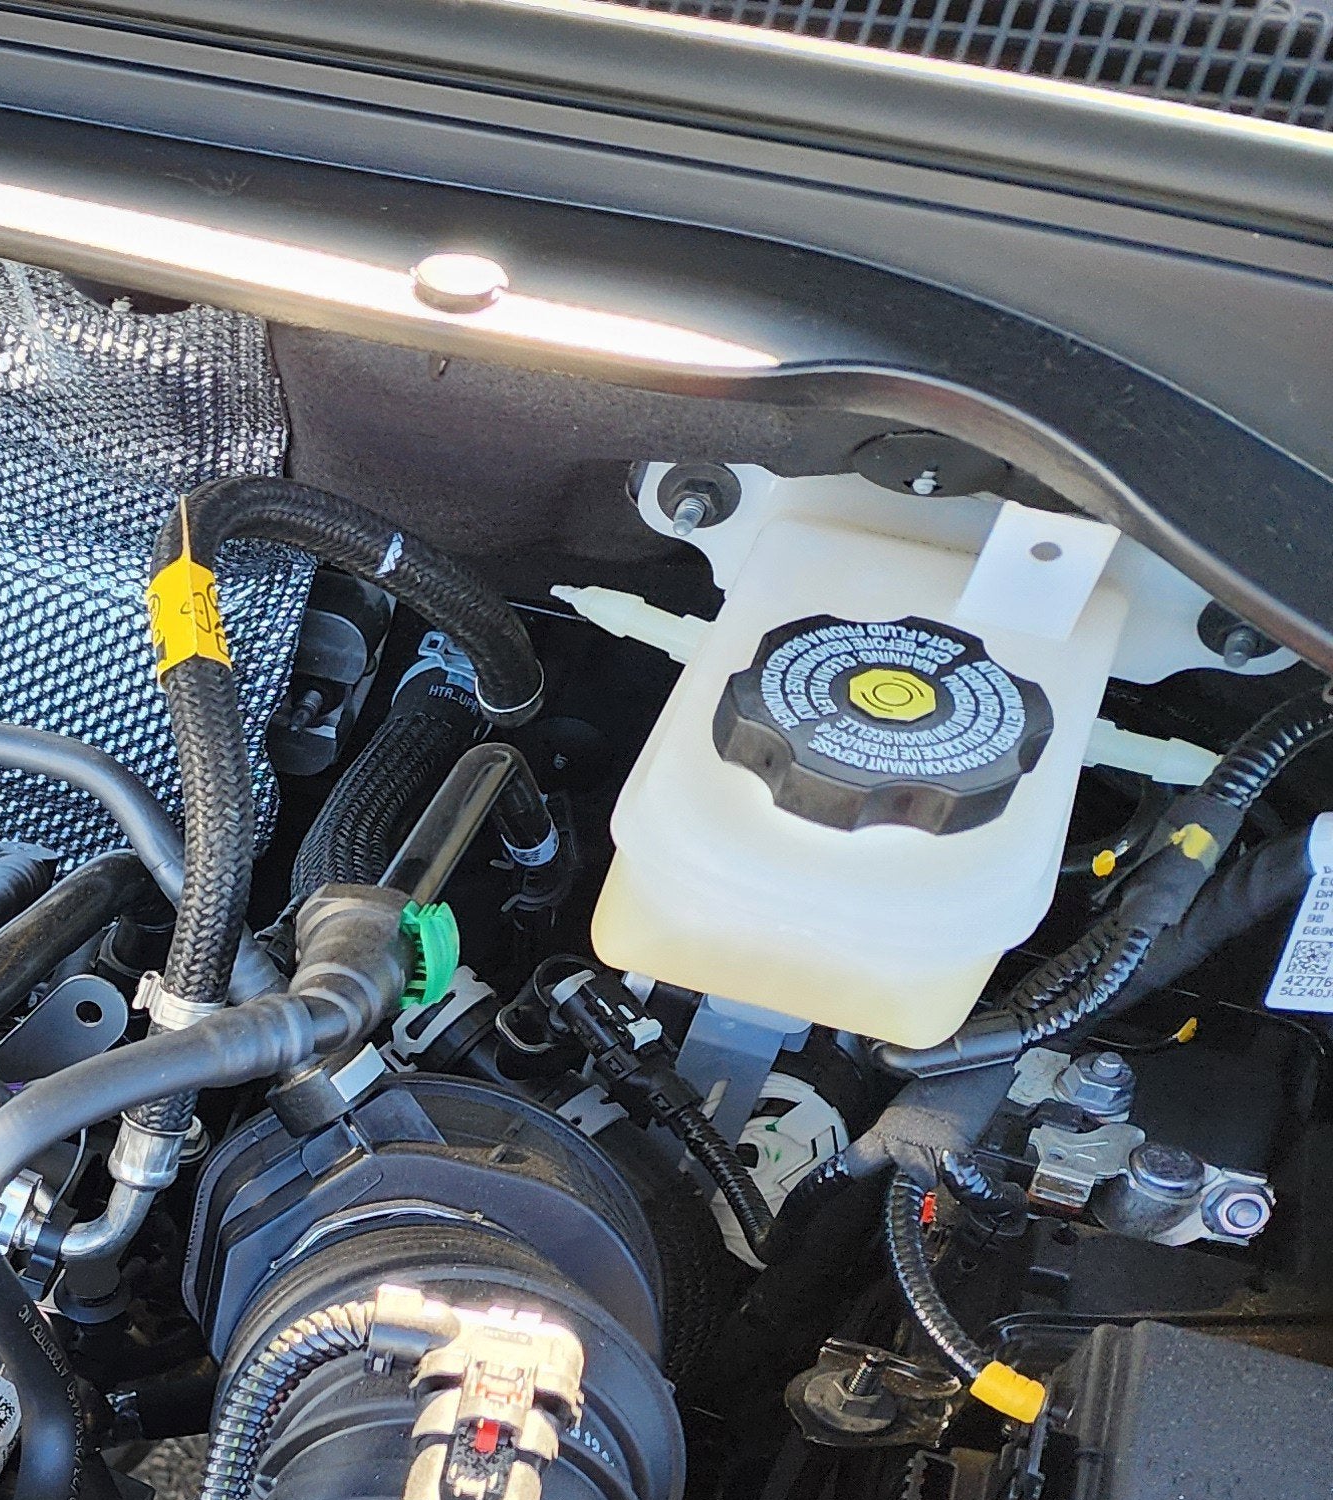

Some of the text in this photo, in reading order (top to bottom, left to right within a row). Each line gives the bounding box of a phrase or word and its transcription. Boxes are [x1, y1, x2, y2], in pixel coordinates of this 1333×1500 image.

[814, 624, 865, 641] FROM
[867, 624, 918, 640] FLUID
[766, 638, 811, 669] SEALED
[852, 637, 917, 652] BEFORE
[916, 644, 953, 665] CAP
[812, 653, 858, 681] CLEAN
[786, 674, 806, 693] USE
[810, 679, 838, 715] FILLER
[788, 695, 819, 721] ONLY
[836, 716, 893, 744] SCELLE
[969, 715, 999, 736] QUE
[893, 729, 941, 746] BIDON
[917, 735, 975, 760] LIQUIDE
[849, 738, 898, 758] FREIN
[898, 746, 923, 760] DE
[973, 743, 1004, 761] LE
[863, 756, 920, 775] AVANT
[917, 749, 990, 776] BOUCHON
